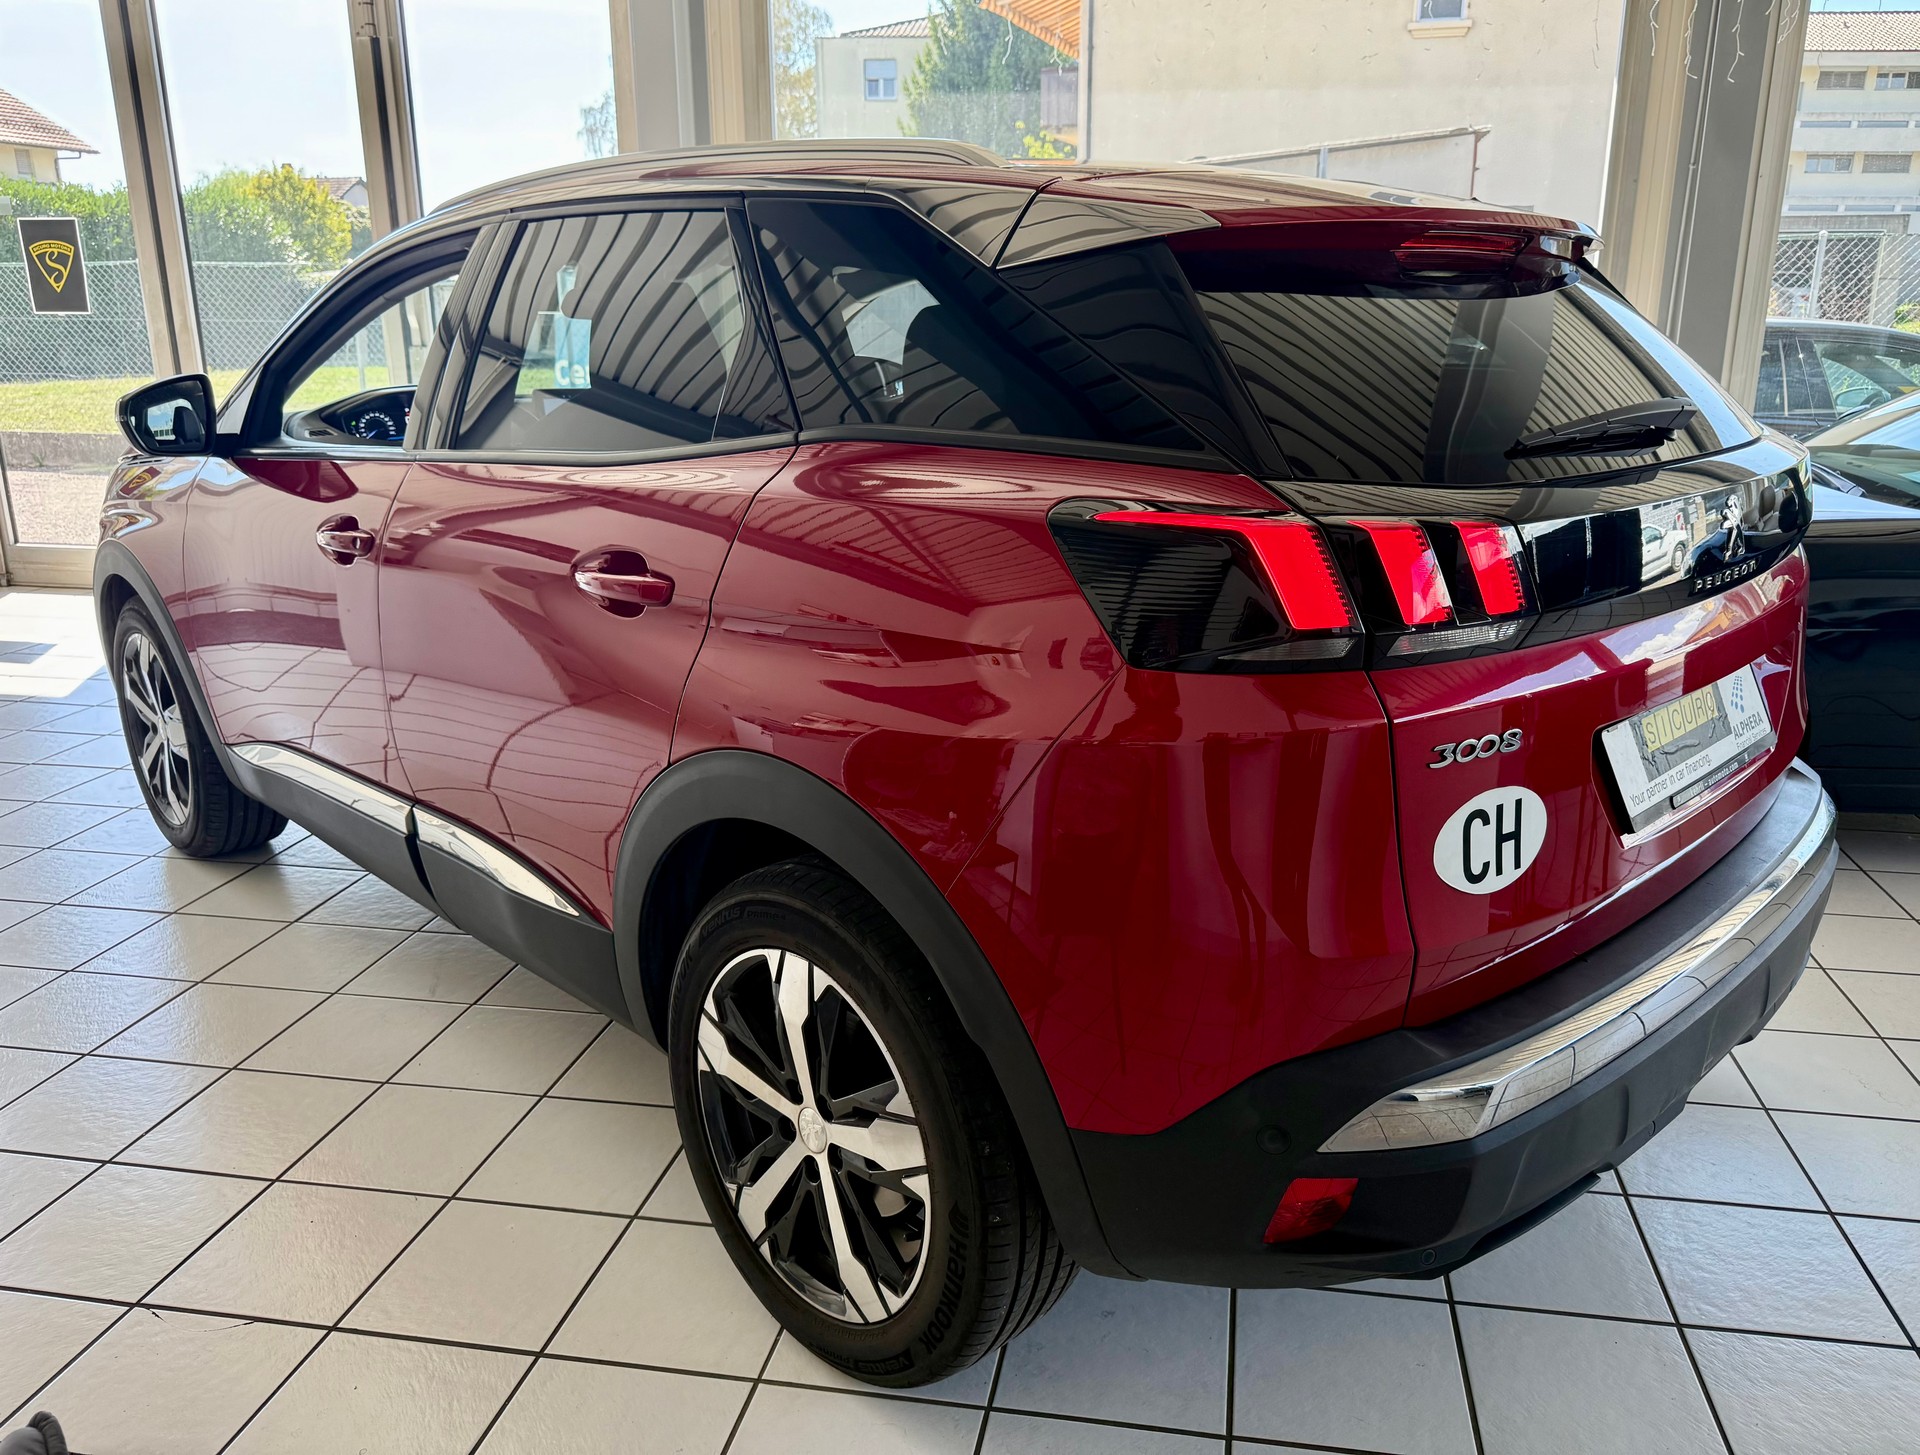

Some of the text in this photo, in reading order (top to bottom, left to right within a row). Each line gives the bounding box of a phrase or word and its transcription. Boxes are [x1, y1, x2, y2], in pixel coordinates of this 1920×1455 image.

[1694, 559, 1758, 593] PEUGEOT
[1645, 690, 1715, 745] SICURO
[1732, 711, 1764, 741] ALPHERA
[1428, 728, 1523, 769] 3008
[1629, 791, 1646, 808] Your
[1645, 777, 1668, 802] partner
[1667, 773, 1676, 785] in
[1675, 767, 1686, 782] car
[1462, 798, 1523, 885] CH
